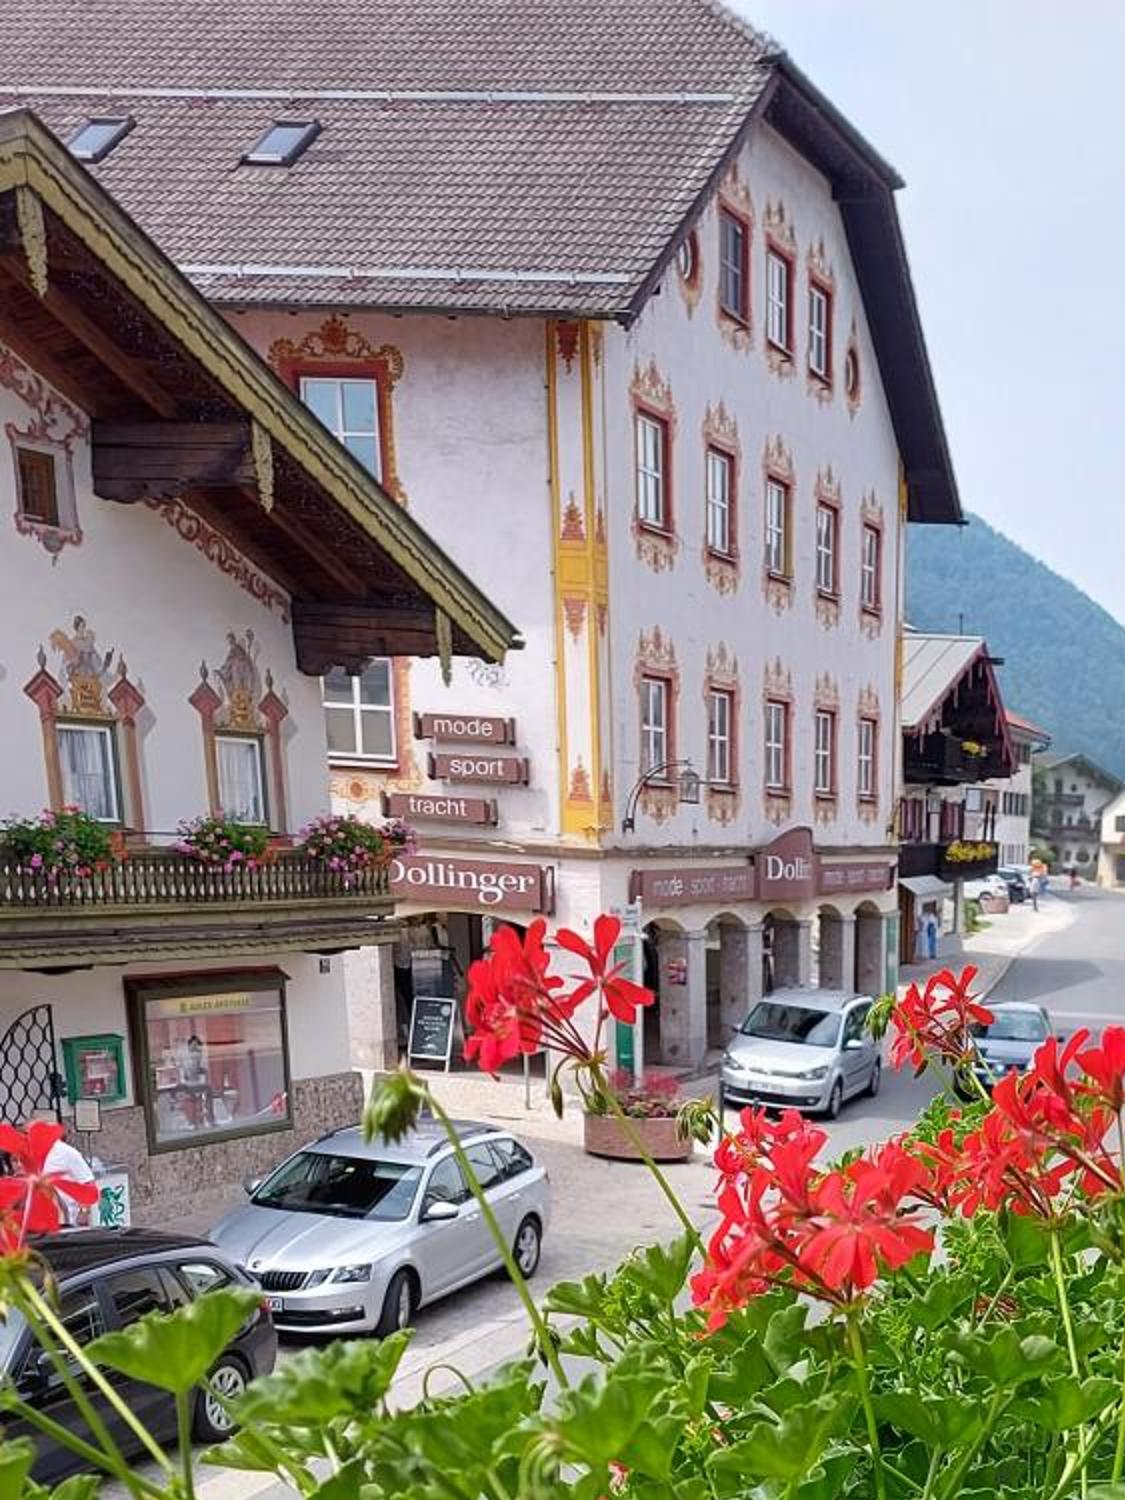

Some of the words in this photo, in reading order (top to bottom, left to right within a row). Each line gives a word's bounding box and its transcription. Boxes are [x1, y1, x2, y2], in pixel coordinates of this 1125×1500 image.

[433, 718, 493, 737] mode
[450, 758, 505, 777] sport
[409, 797, 468, 817] tracht
